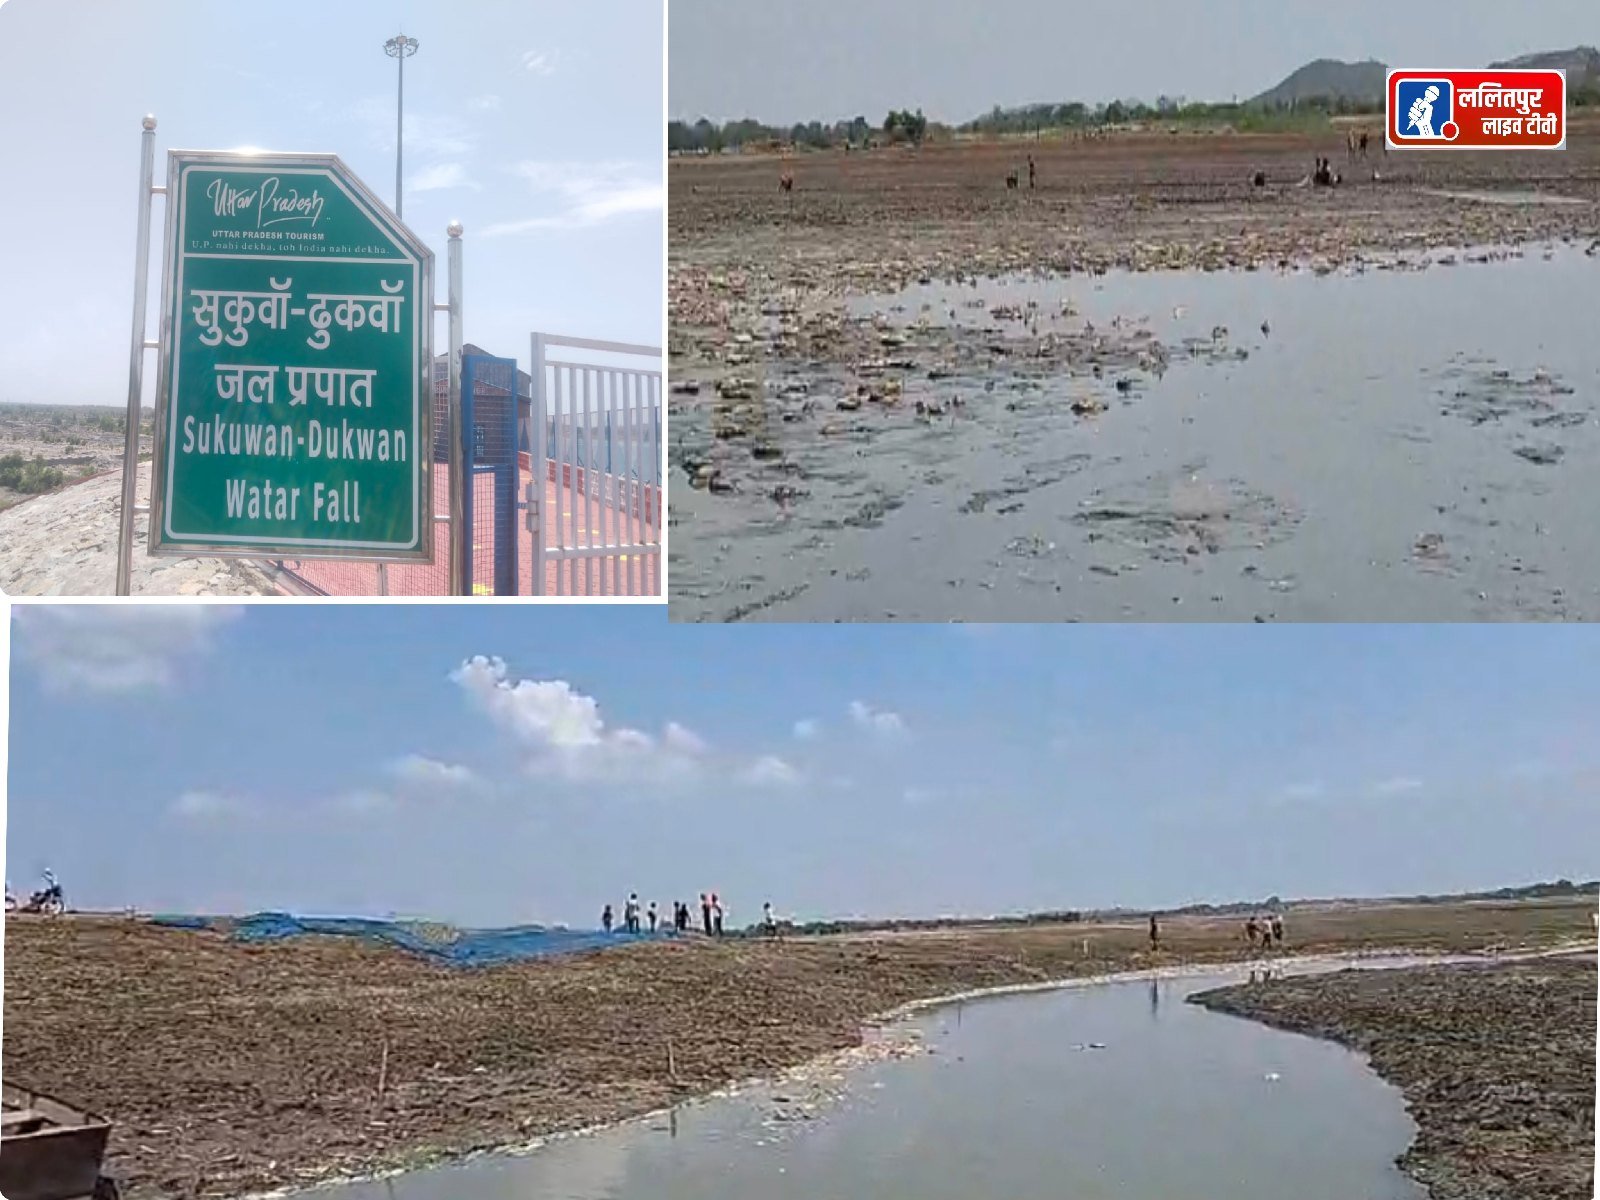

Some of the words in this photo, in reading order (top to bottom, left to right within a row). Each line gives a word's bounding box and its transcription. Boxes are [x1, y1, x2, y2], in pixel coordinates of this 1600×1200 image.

[212, 230, 240, 238] UTTAR
[242, 231, 282, 239] PRADESH
[286, 232, 325, 240] TOURISM
[214, 364, 279, 404] जल
[285, 367, 377, 408] प्रपात
[183, 413, 406, 462] Sukuwan-Dukwan
[226, 480, 300, 520] Watar
[313, 481, 360, 523] Fall
